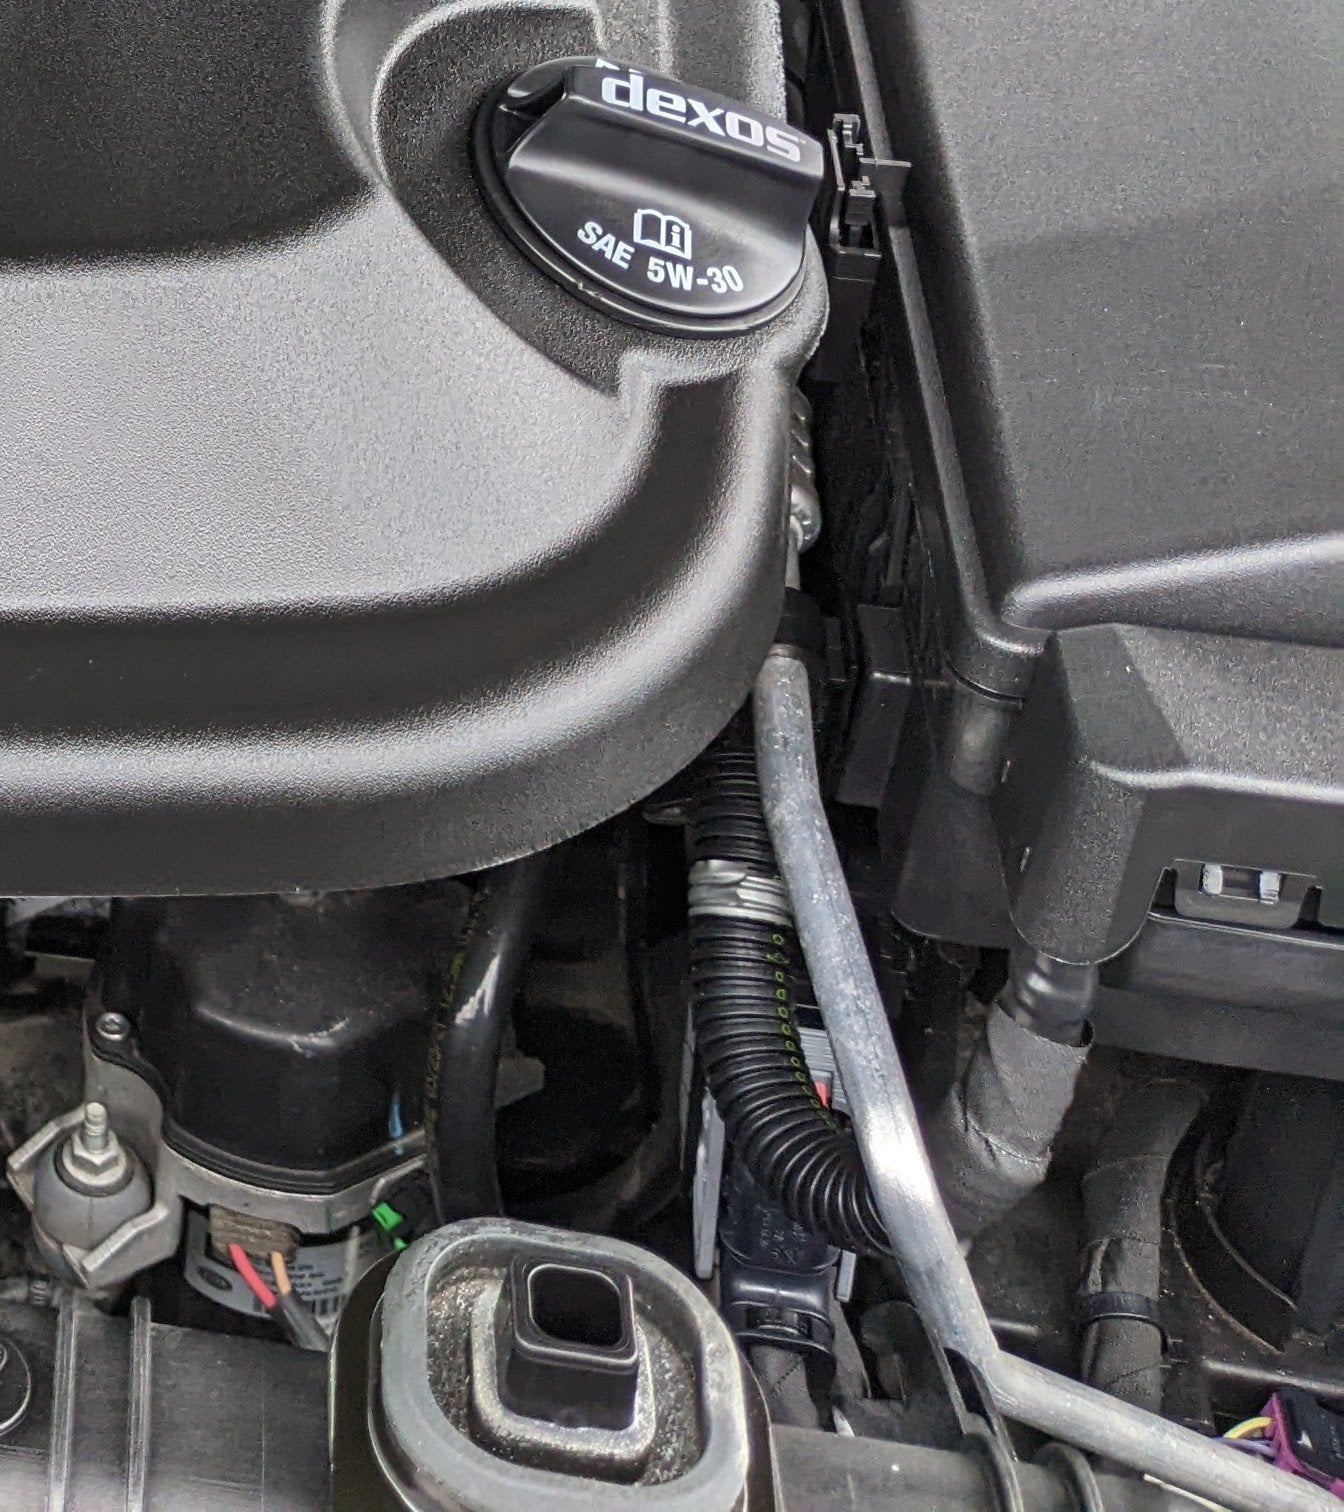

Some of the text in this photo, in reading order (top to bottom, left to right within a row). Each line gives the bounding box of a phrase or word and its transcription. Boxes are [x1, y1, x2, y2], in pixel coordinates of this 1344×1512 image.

[601, 71, 802, 163] dexos
[577, 220, 744, 294] SAE 5W-30
